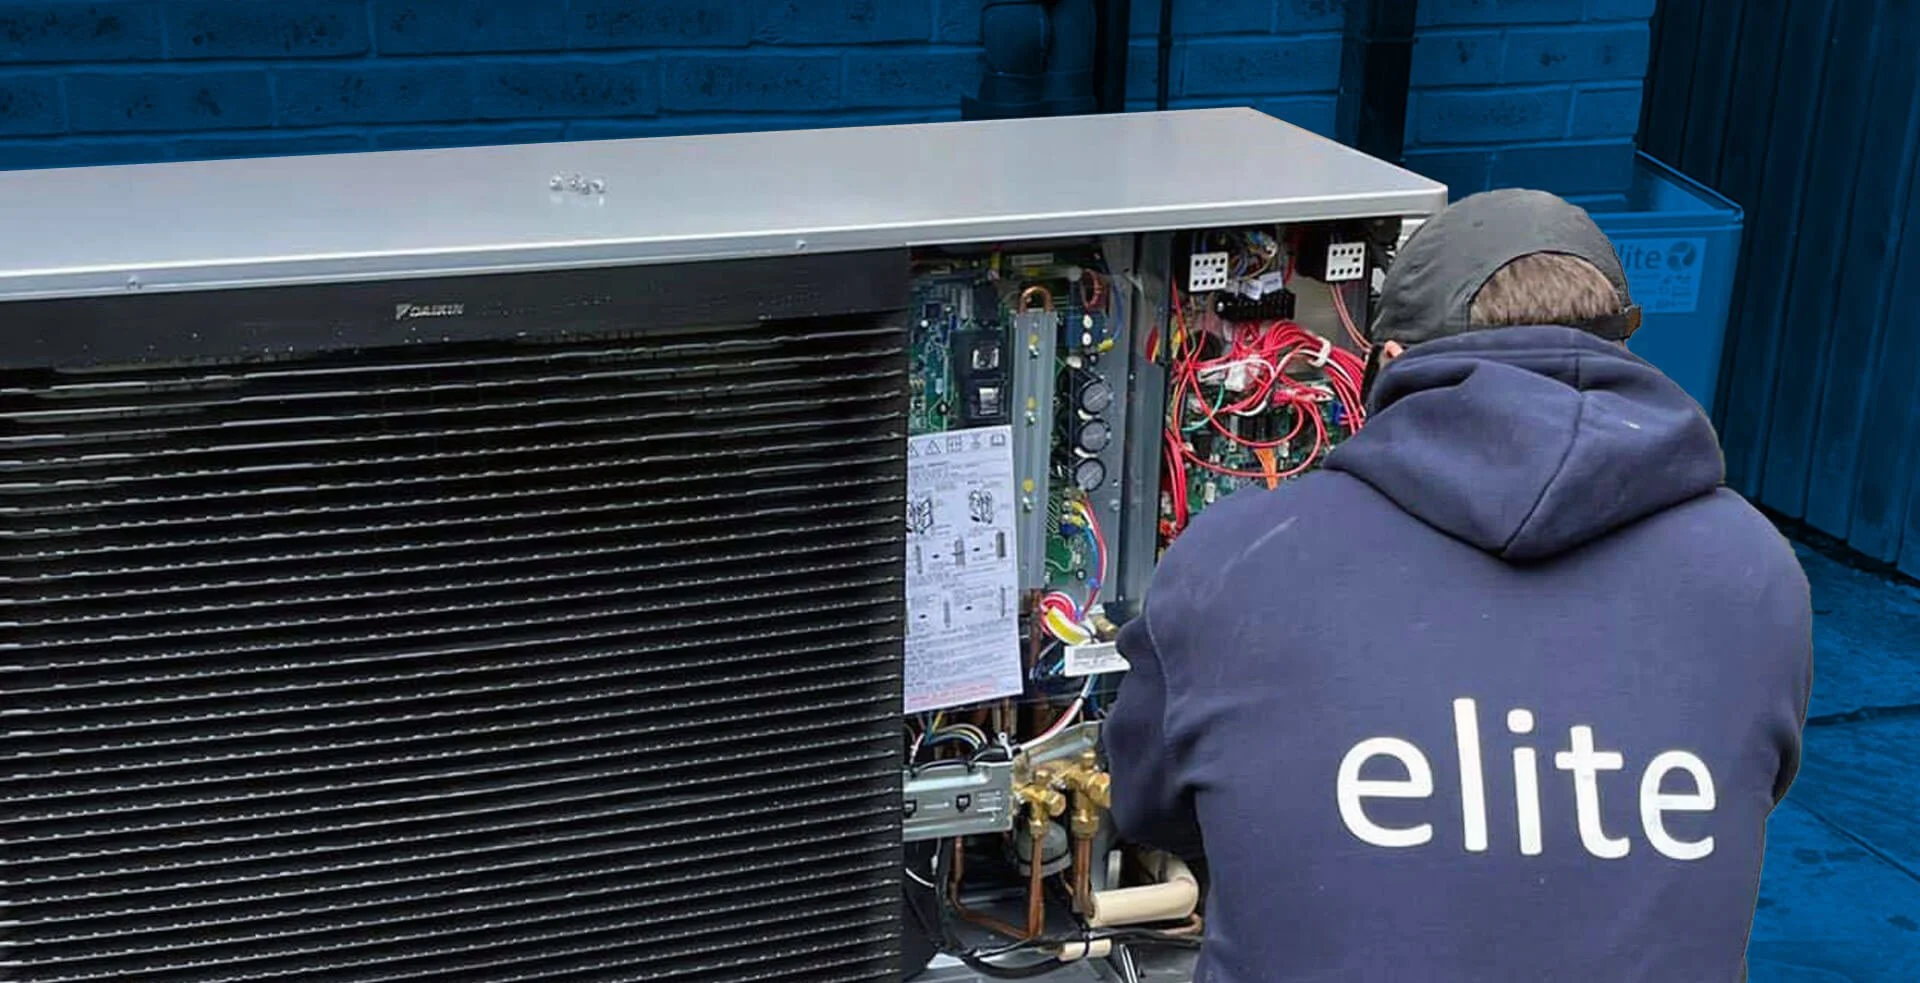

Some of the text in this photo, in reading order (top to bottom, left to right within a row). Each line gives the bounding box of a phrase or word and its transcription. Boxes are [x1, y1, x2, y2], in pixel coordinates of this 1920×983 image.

[1617, 243, 1662, 270] lite
[409, 304, 464, 317] DAIKIN
[1336, 698, 1716, 860] elite
